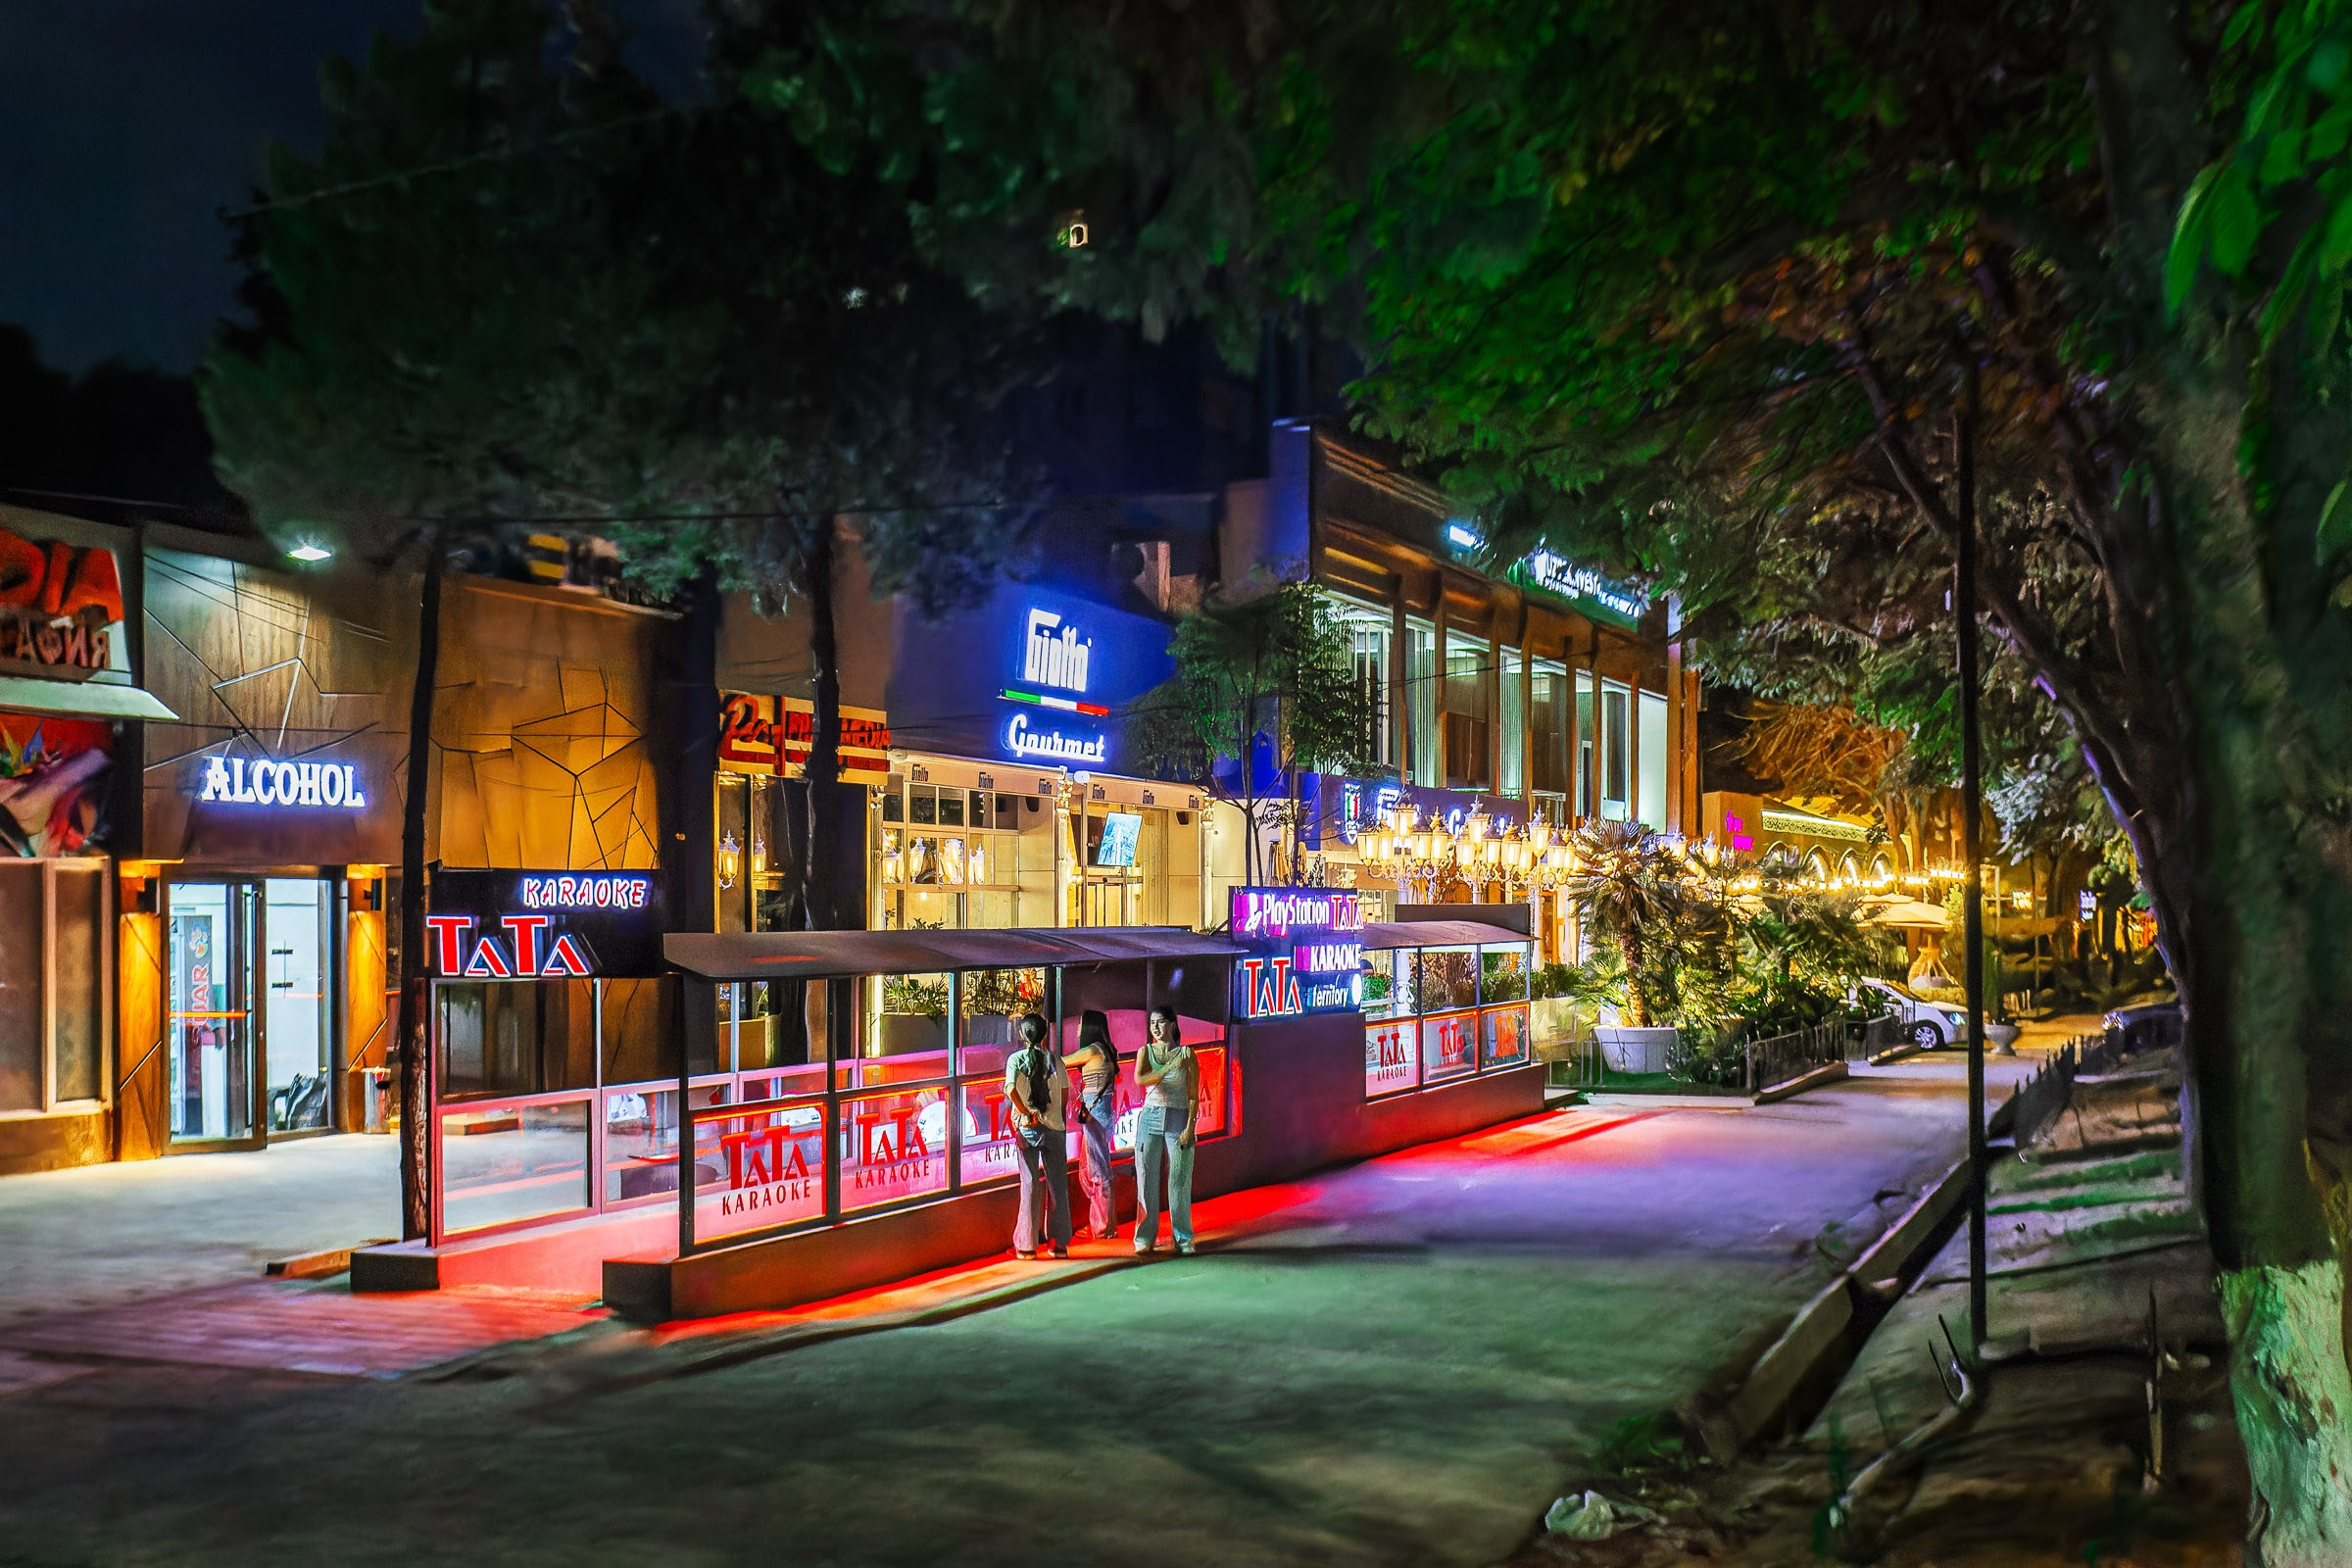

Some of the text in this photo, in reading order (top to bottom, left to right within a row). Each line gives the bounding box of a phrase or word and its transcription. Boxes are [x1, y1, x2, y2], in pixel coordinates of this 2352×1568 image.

[1008, 713, 1104, 761] Gourmet
[201, 757, 365, 808] ALCOHOL
[523, 876, 647, 909] KARAOKE
[1263, 894, 1330, 937] PlayStation
[1310, 944, 1361, 972] KARAOKE
[984, 1093, 1016, 1143] TA
[984, 1141, 1018, 1163] KARA
[855, 1160, 930, 1190] KARAOKE
[720, 1178, 811, 1216] KARAOKE
